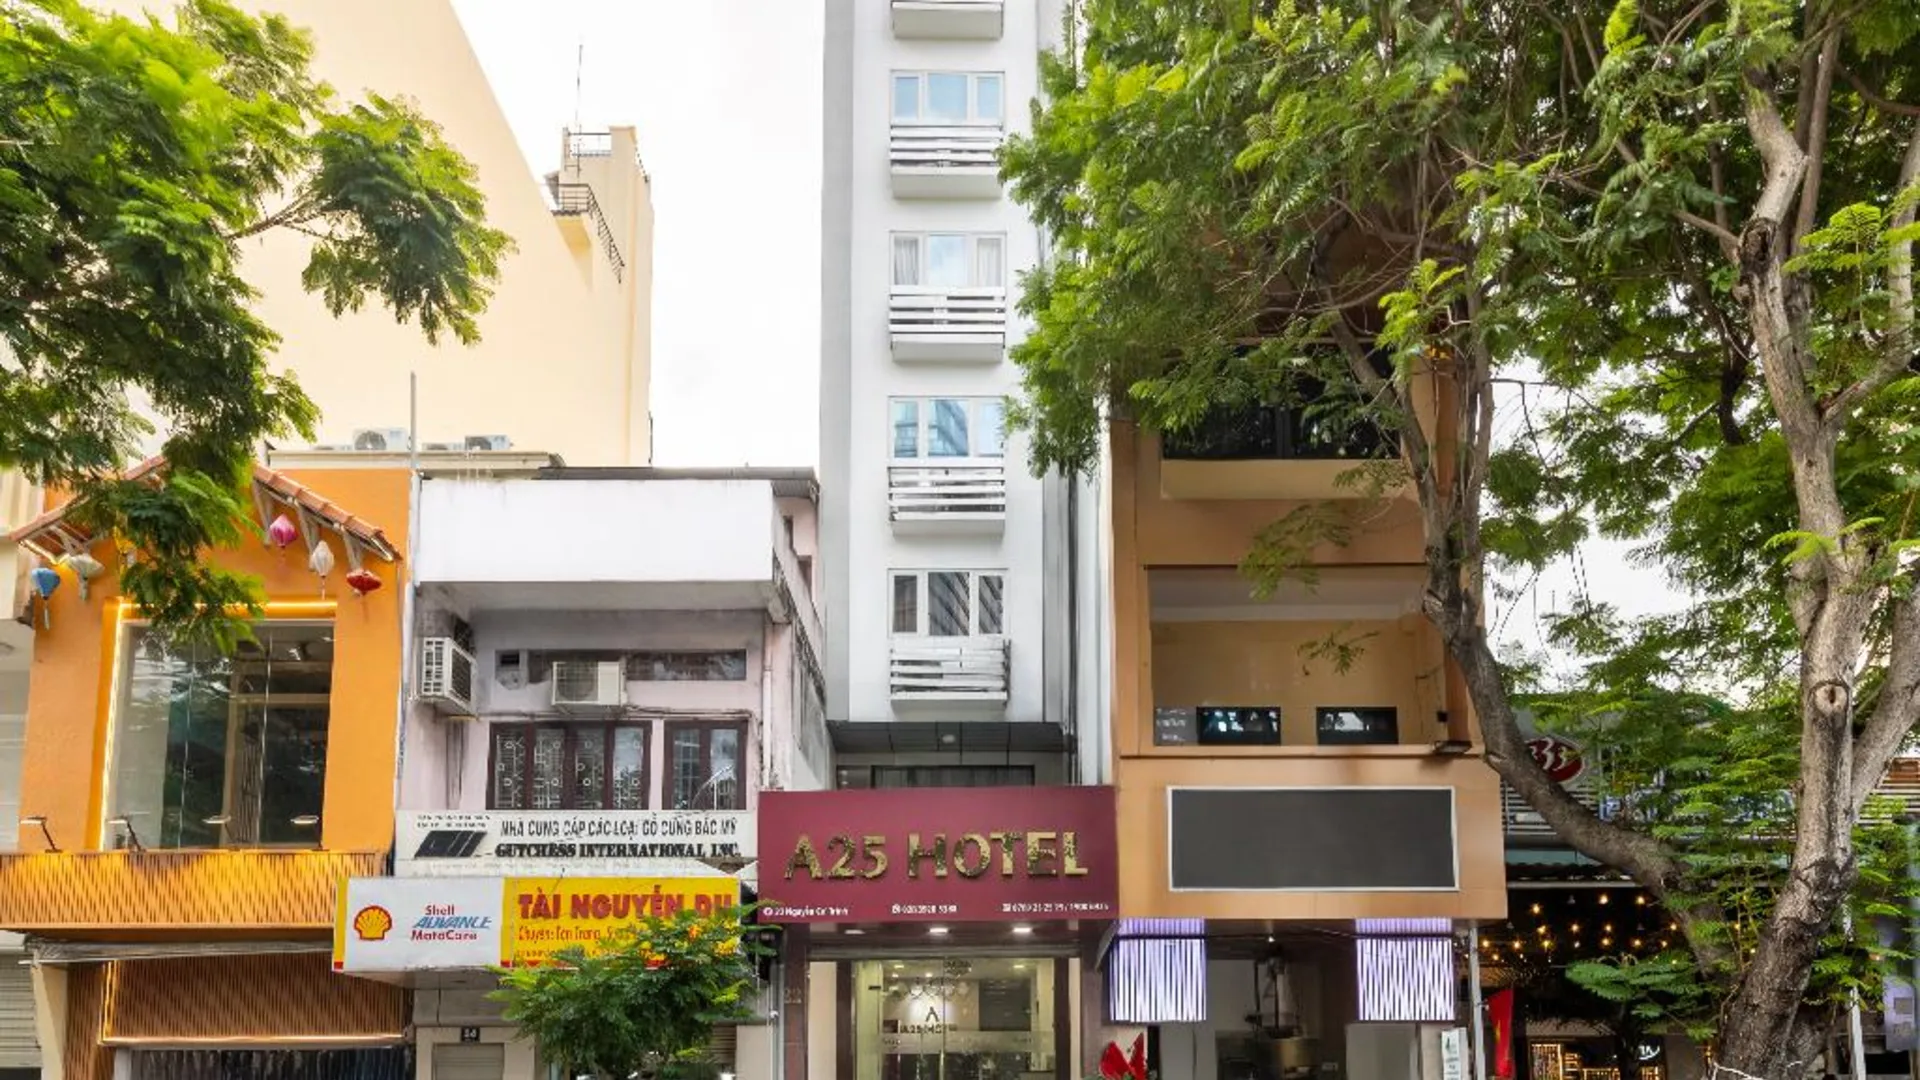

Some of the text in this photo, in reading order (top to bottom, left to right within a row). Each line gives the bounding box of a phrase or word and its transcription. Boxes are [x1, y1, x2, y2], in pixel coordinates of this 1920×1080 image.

[501, 818, 524, 836] NHÀ
[529, 820, 560, 837] CUNG
[588, 817, 612, 837] CÁC
[495, 842, 577, 858] GUTCHESS
[579, 842, 706, 858] INTERNATIONAL
[783, 831, 1089, 879] A25 HOTEL
[425, 904, 455, 916] Shell
[518, 887, 561, 920] TÀI
[413, 916, 492, 929] ADVANCE
